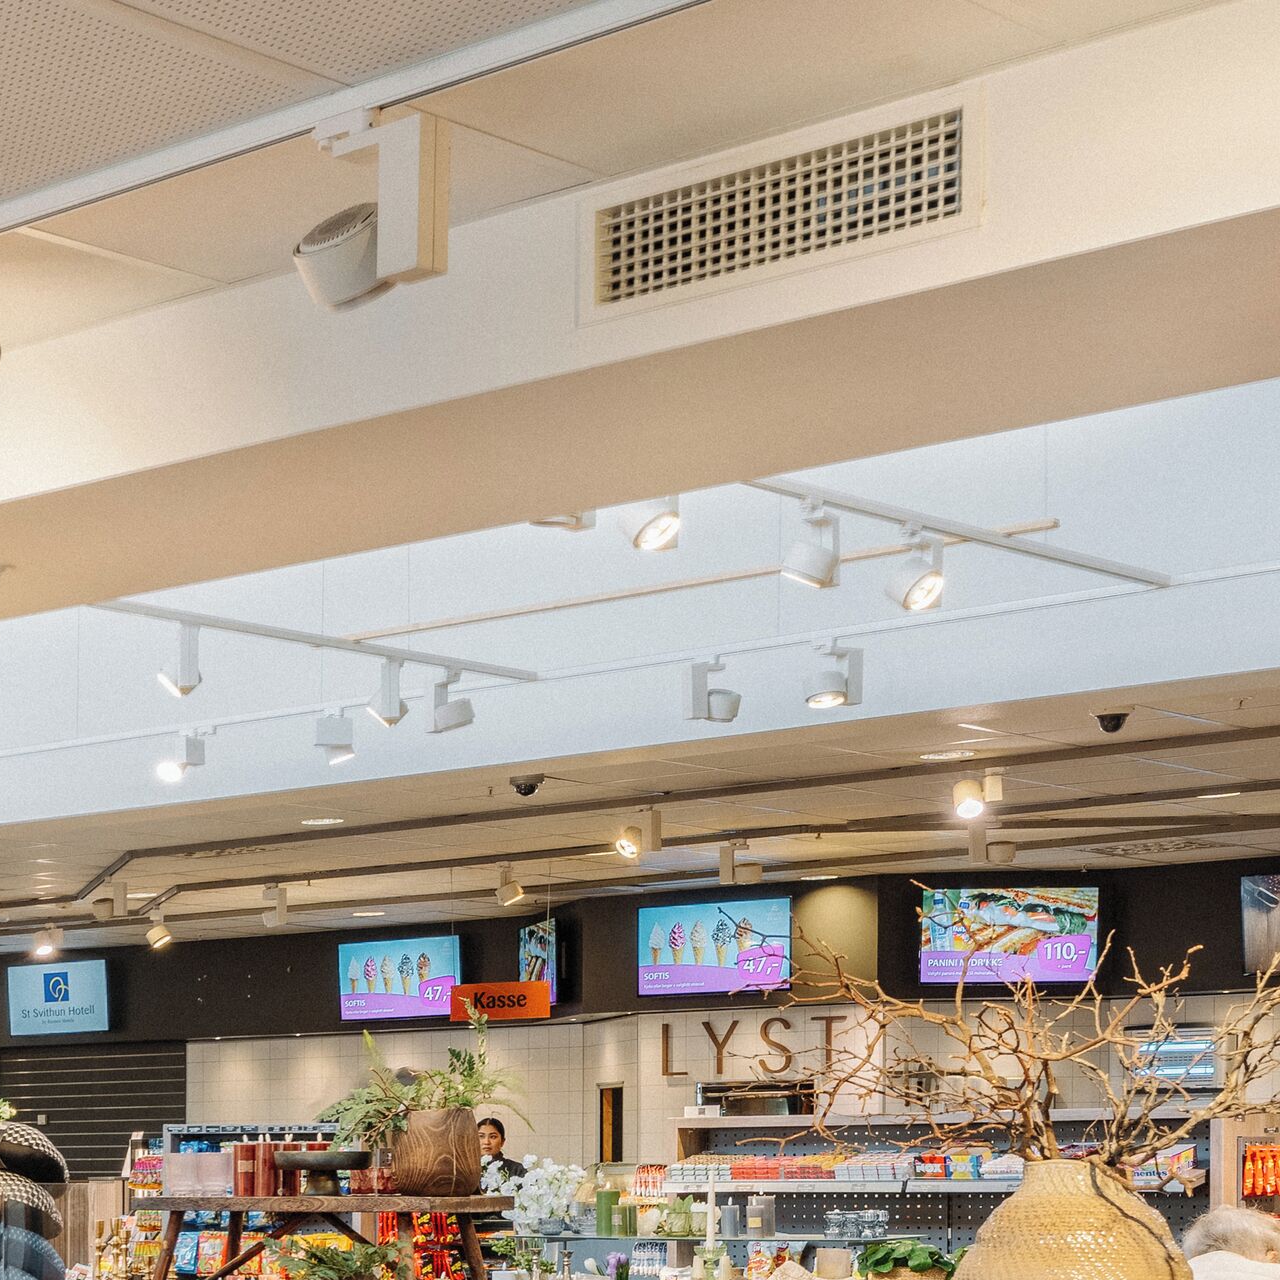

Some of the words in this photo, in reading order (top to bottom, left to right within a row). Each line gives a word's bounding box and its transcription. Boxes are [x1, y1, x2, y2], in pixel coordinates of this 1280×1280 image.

[927, 958, 958, 967] PANINI
[643, 971, 670, 981] SOFTIS
[344, 999, 366, 1008] SOFTIS
[473, 991, 527, 1010] Kasse
[21, 1009, 31, 1019] St
[33, 1007, 66, 1018] Svithun
[68, 1005, 95, 1016] Hotell
[661, 1015, 848, 1076] LYST
